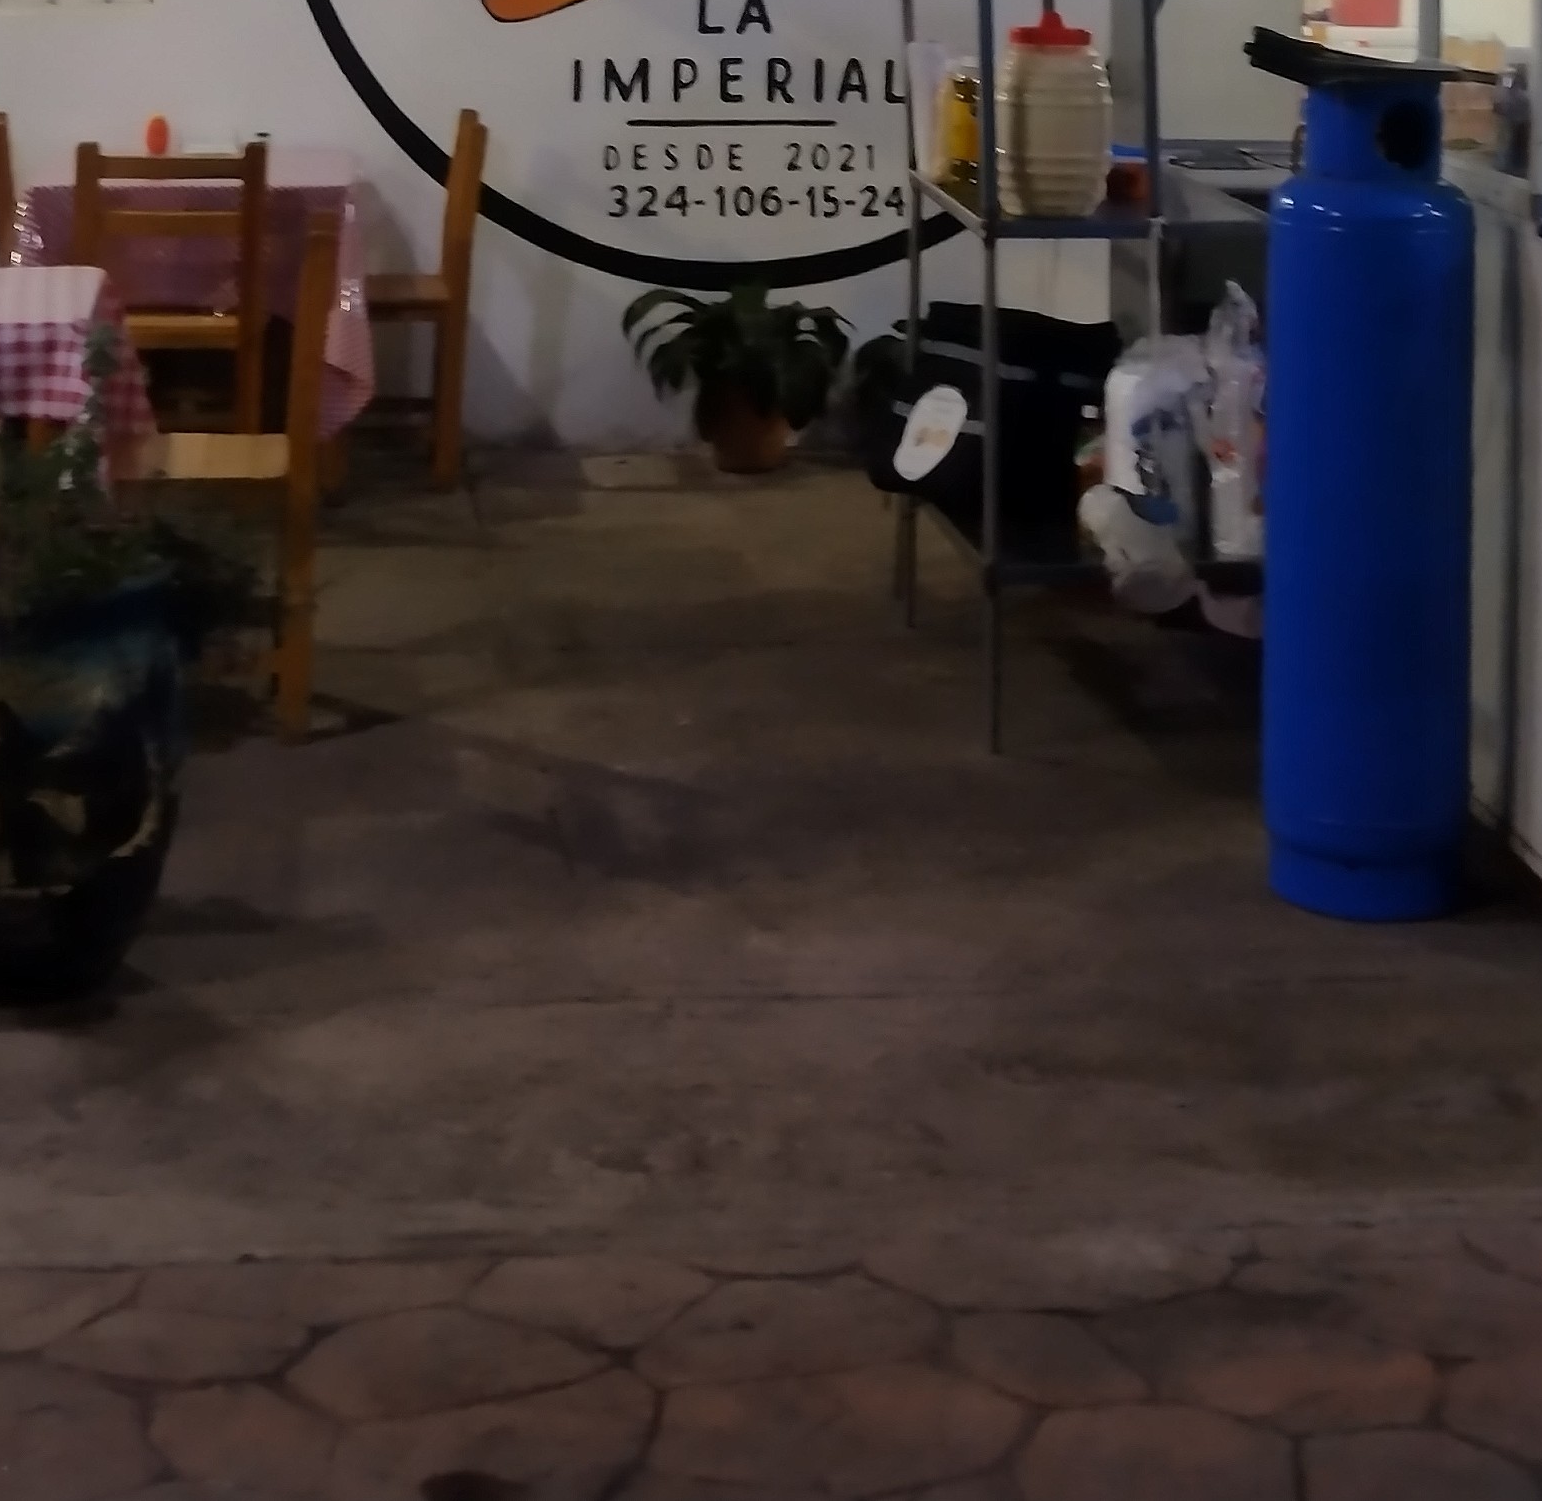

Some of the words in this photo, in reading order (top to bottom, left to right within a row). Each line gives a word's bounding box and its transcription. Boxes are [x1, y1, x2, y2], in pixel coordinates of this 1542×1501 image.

[572, 57, 909, 105] IMPERIAL
[603, 142, 745, 173] DESDE
[785, 142, 877, 173] 2021
[608, 184, 907, 219] 324-106-15-24
